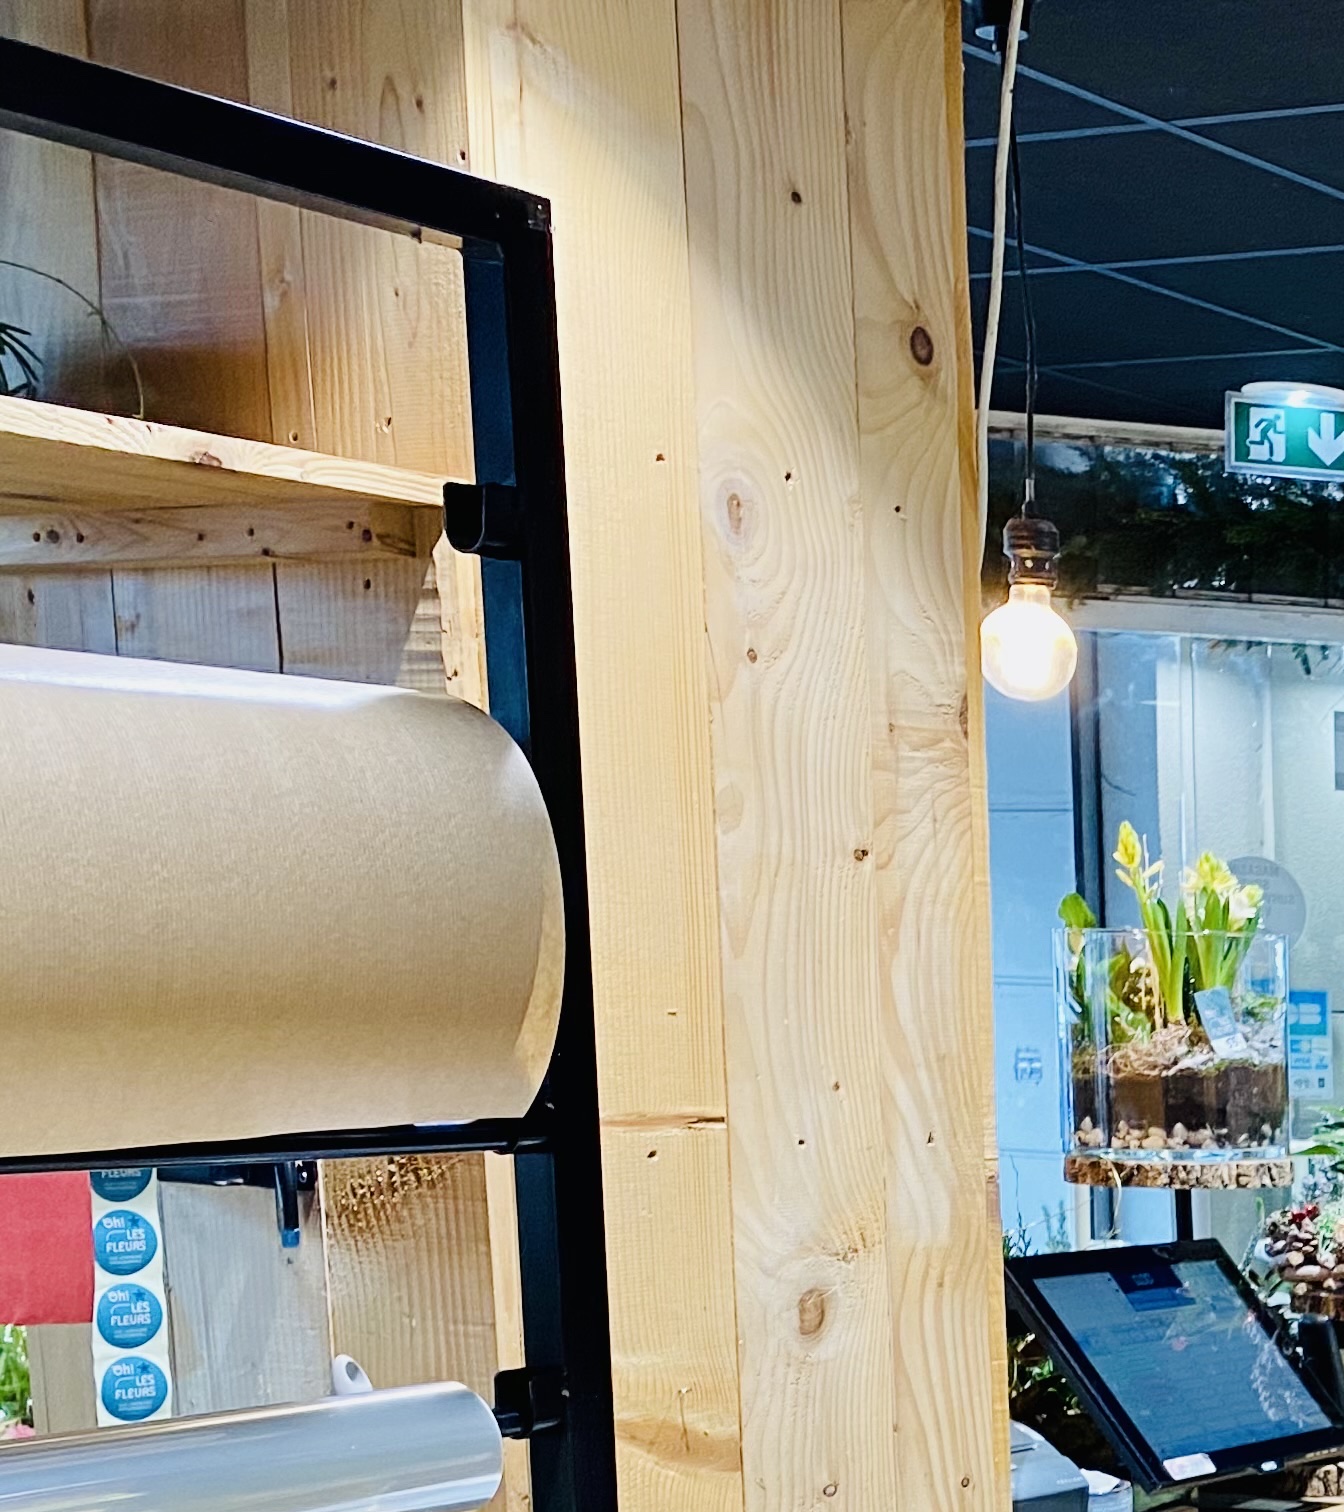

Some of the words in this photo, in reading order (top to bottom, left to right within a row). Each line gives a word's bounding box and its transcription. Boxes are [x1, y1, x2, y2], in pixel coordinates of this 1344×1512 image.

[126, 1228, 146, 1241] LES
[106, 1240, 147, 1253] FLEURS
[130, 1300, 151, 1313] LES
[110, 1313, 151, 1326] FLEURS
[135, 1374, 155, 1386] LES
[114, 1386, 156, 1400] FLEURS
